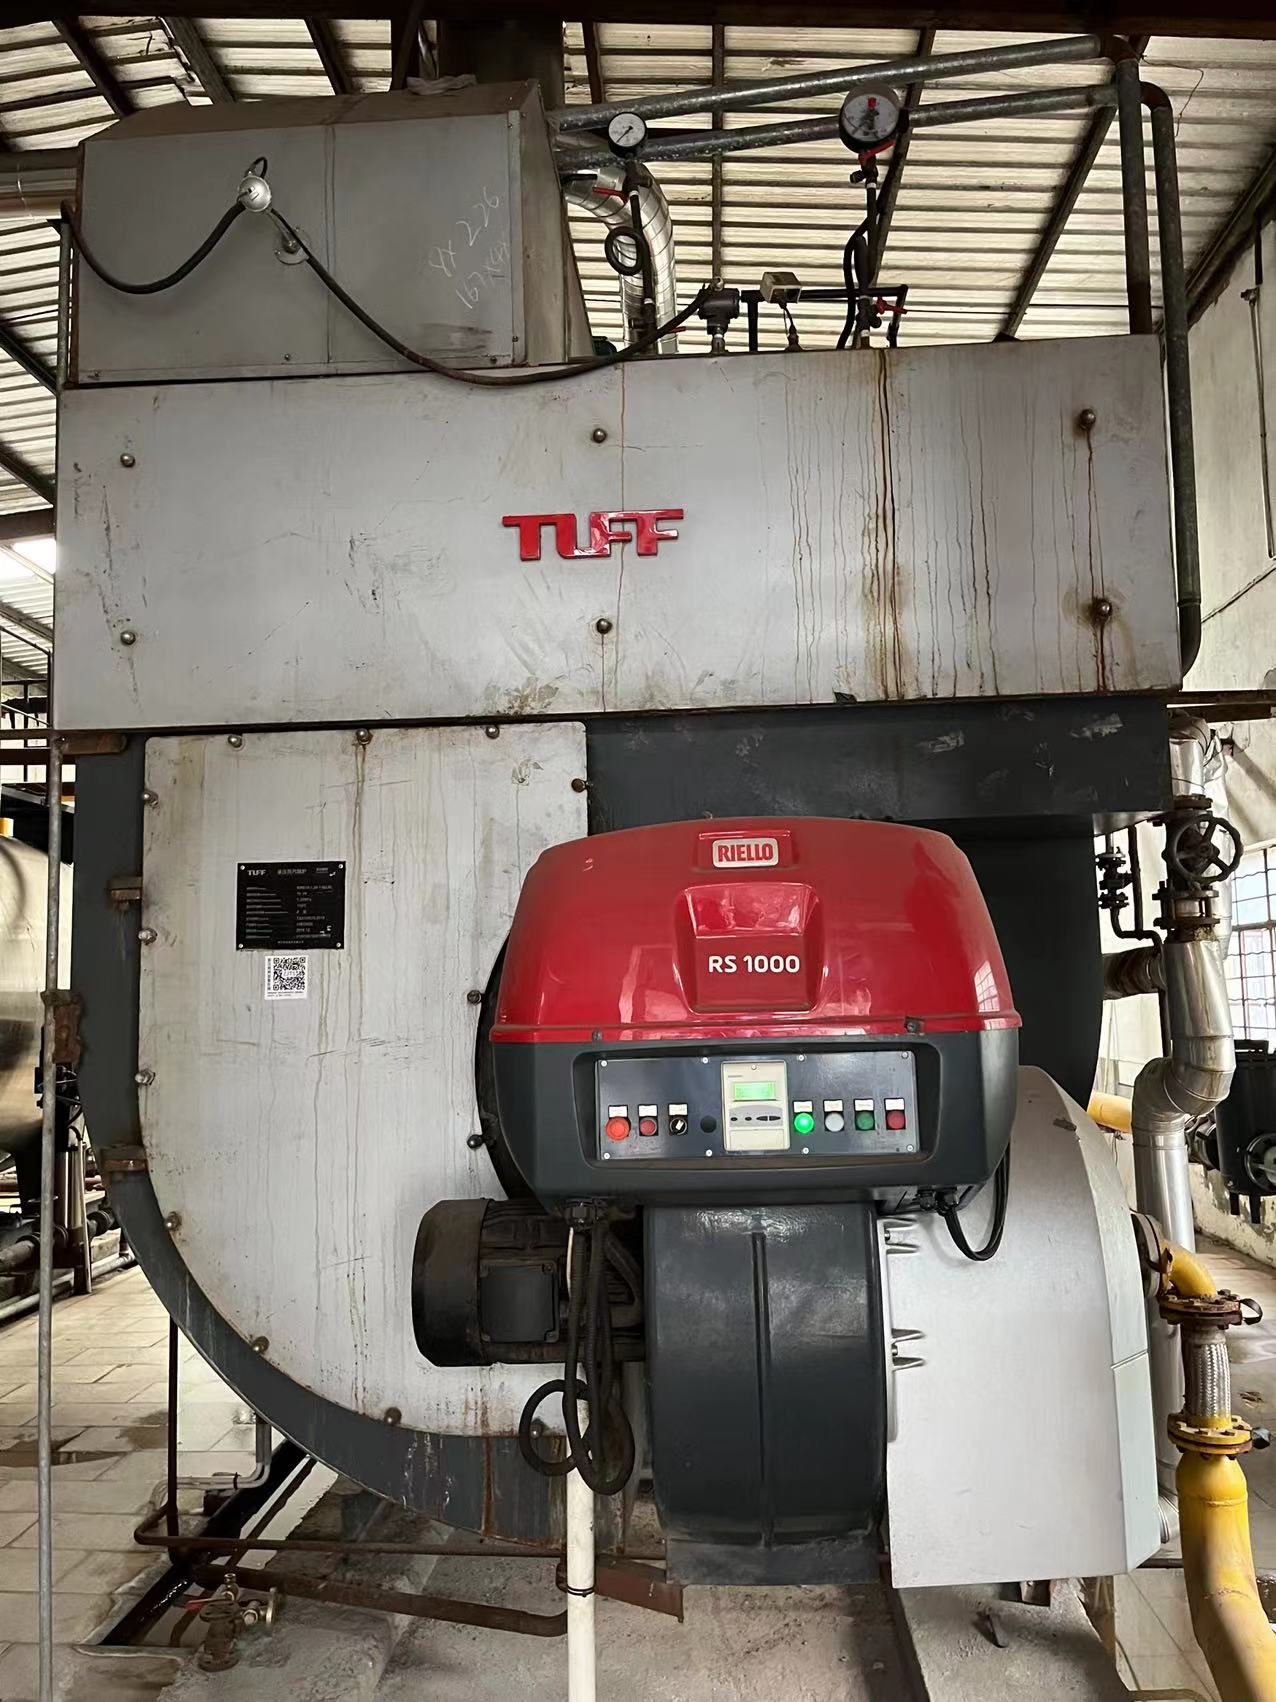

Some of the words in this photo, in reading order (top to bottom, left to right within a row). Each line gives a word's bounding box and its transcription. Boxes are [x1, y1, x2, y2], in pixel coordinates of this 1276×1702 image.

[502, 508, 684, 562] TUFF
[717, 843, 774, 862] RIELLO
[708, 955, 738, 973] RS
[742, 955, 801, 973] 1000
